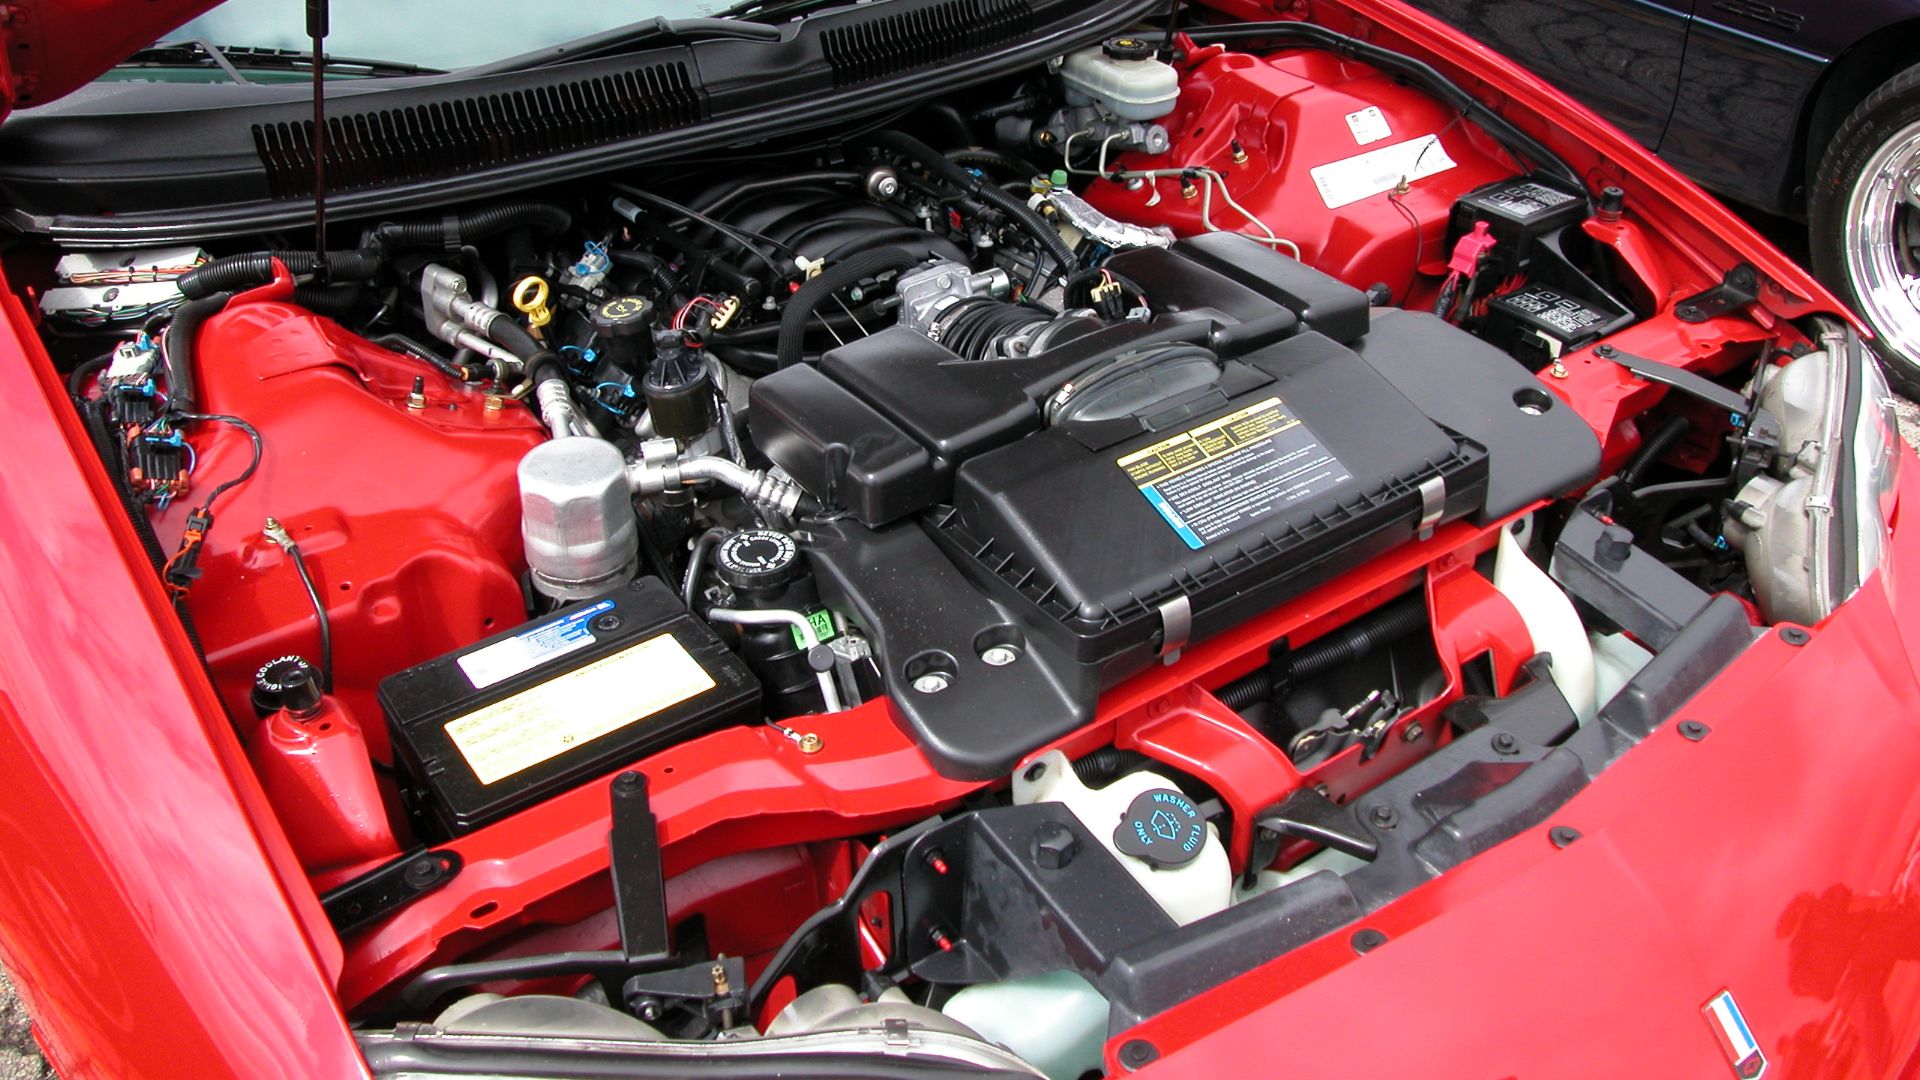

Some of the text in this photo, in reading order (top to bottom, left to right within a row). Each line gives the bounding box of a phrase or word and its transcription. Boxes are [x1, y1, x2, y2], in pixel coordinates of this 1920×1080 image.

[256, 655, 300, 678] COOLANT
[1134, 821, 1154, 846] ONLY
[1152, 793, 1201, 852] WASHER FLUID
